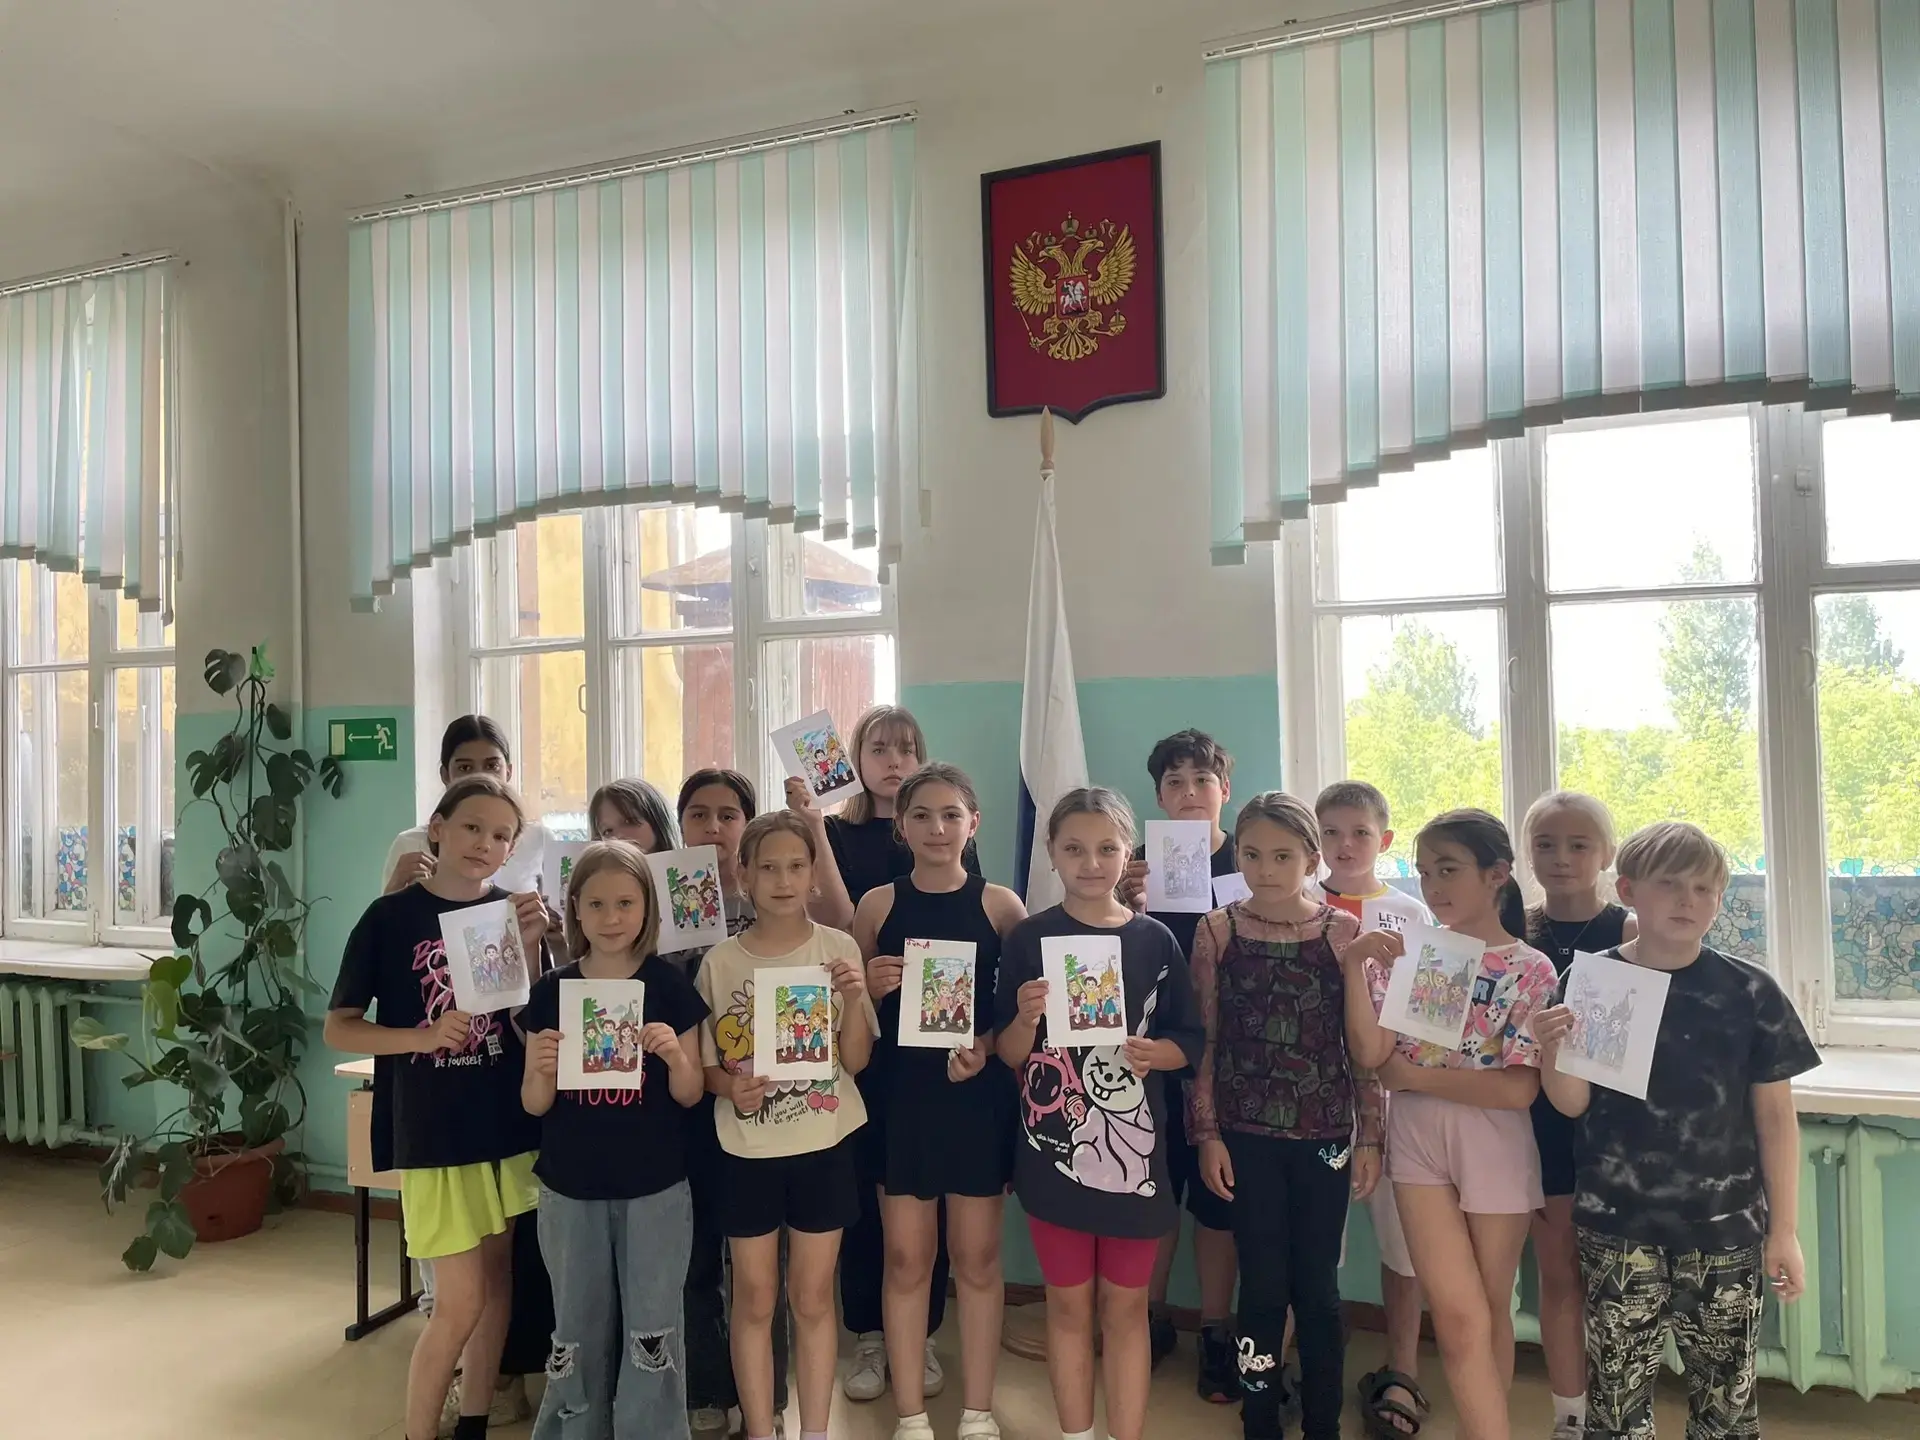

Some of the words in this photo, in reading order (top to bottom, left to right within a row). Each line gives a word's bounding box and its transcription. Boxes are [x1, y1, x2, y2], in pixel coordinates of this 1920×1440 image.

[434, 1056, 446, 1068] BE
[447, 1054, 484, 1068] YOURSELF
[773, 1117, 783, 1125] be
[786, 1106, 809, 1123] great!
[774, 1108, 788, 1119] you
[790, 1100, 804, 1112] will
